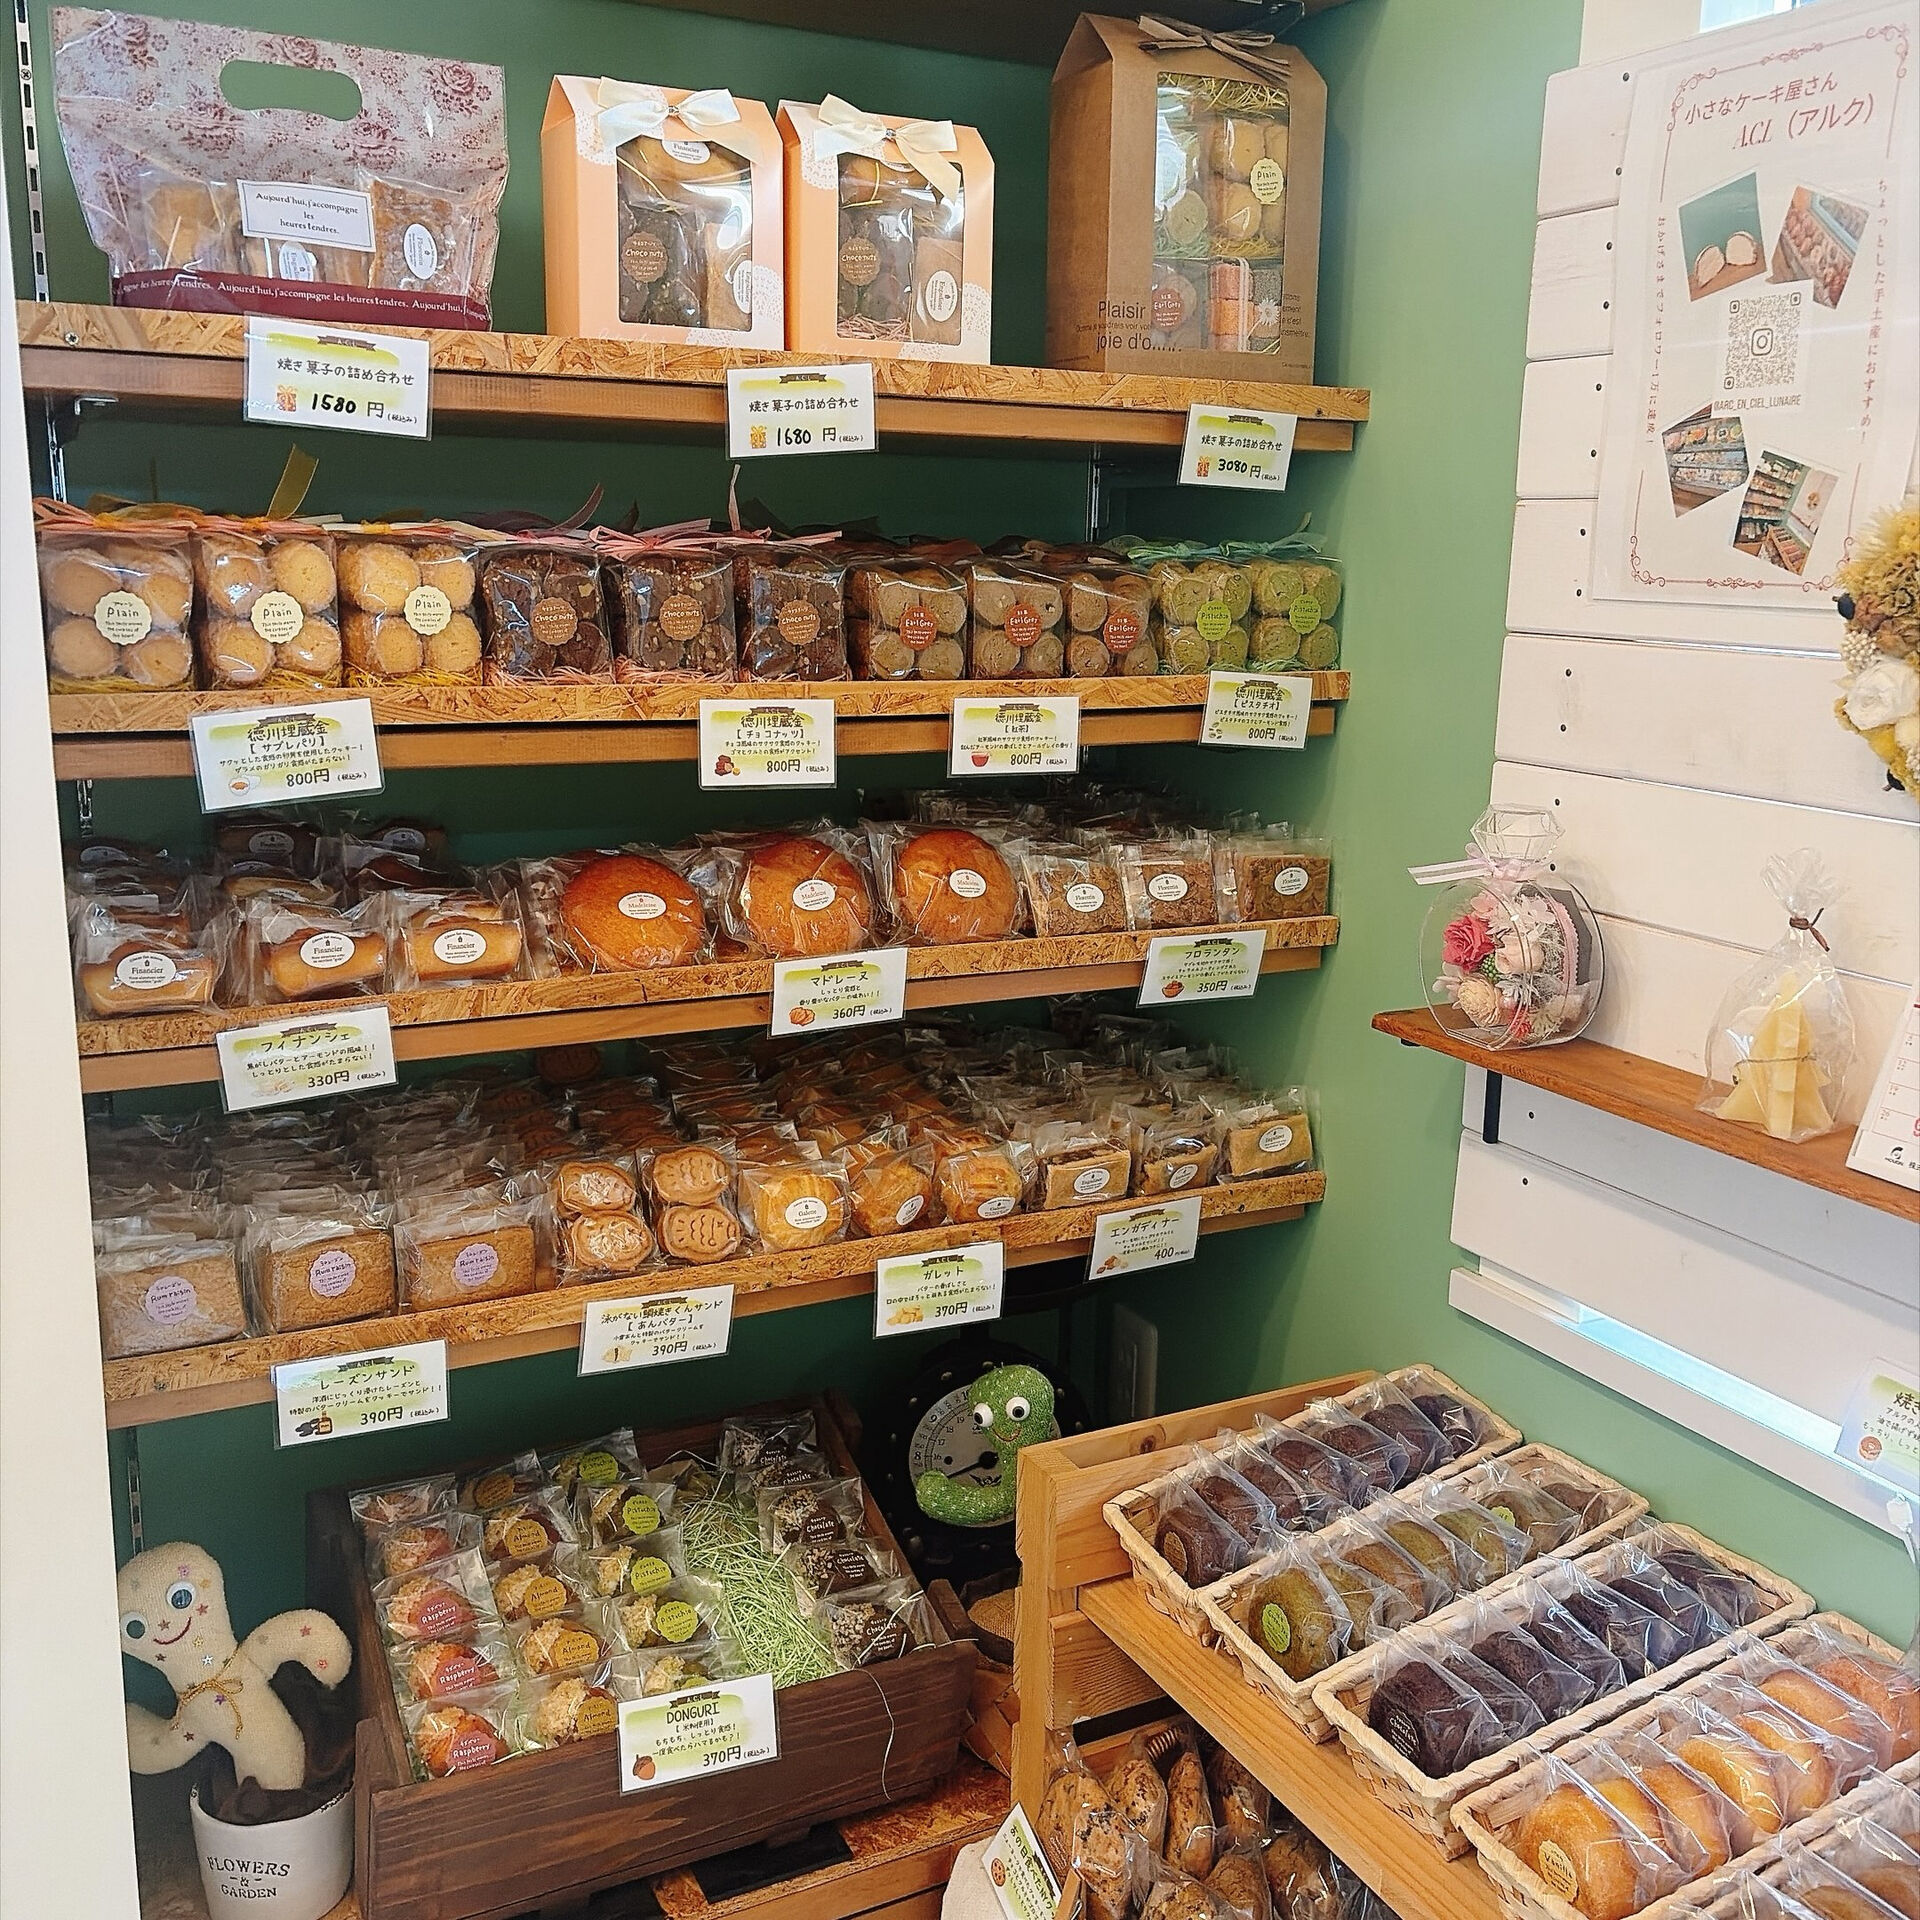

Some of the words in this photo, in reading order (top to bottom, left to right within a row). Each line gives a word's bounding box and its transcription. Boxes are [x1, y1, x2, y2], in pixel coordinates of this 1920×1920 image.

[1685, 72, 1838, 125] 小さなケーキ屋さん
[303, 211, 314, 220] les
[333, 292, 345, 302] les
[1098, 300, 1145, 319] Plaisir
[1097, 334, 1122, 352] joie
[277, 357, 415, 386] 焼き菓子の詰め合わせ
[311, 393, 357, 414] 1580
[367, 401, 384, 418] 円
[749, 397, 859, 413] 焼き菓子の詰め合わせ
[777, 427, 811, 446] 1680
[822, 427, 836, 442] 円
[1201, 434, 1283, 451] 焼き菓子の詰め合わせ
[1218, 458, 1248, 473] 3080
[1250, 465, 1261, 478] 円
[415, 599, 442, 609] Plain
[107, 607, 139, 618] Plain
[263, 608, 292, 619] Plain
[535, 614, 556, 622] Choco
[663, 610, 685, 618] Choco
[781, 616, 803, 624] Choco
[741, 714, 805, 729] 徳川埋蔵金
[248, 720, 330, 742] 徳川埋蔵金
[1248, 728, 1275, 740] 800円
[767, 759, 800, 773] 800円
[1011, 752, 1041, 765] 800円
[286, 768, 330, 787] 800円
[313, 946, 343, 954] Financier
[446, 942, 475, 951] Financier
[1185, 947, 1240, 959] フロランタン
[811, 971, 868, 987] マドレーヌ
[1197, 980, 1228, 993] 350円
[833, 1005, 866, 1019] 360円
[261, 1032, 351, 1053] フィナンシェ
[307, 1070, 350, 1088] 330円
[1110, 1217, 1179, 1238] エンガディナー
[475, 1255, 495, 1264] raisin
[1154, 1247, 1174, 1260] 400
[315, 1267, 331, 1277] Rum
[331, 1262, 351, 1273] raisin
[923, 1266, 964, 1280] ガレット
[151, 1292, 168, 1304] Rum
[169, 1288, 192, 1298] raisin
[935, 1301, 968, 1318] 370円
[652, 1341, 688, 1357] 390円
[320, 1364, 415, 1391] レーズンサンド
[361, 1406, 403, 1425] 390円
[806, 1521, 836, 1533] Chocolate
[421, 1605, 456, 1625] Raspberry
[562, 1642, 591, 1654] Almond
[439, 1665, 475, 1684] Raspberry
[666, 1702, 720, 1724] DONGURI
[453, 1743, 490, 1759] Raspberry
[703, 1745, 741, 1767] 370円
[207, 1856, 291, 1877] FLOWERS
[1544, 1851, 1572, 1879] Vanilla
[221, 1884, 277, 1899] GARDEN
